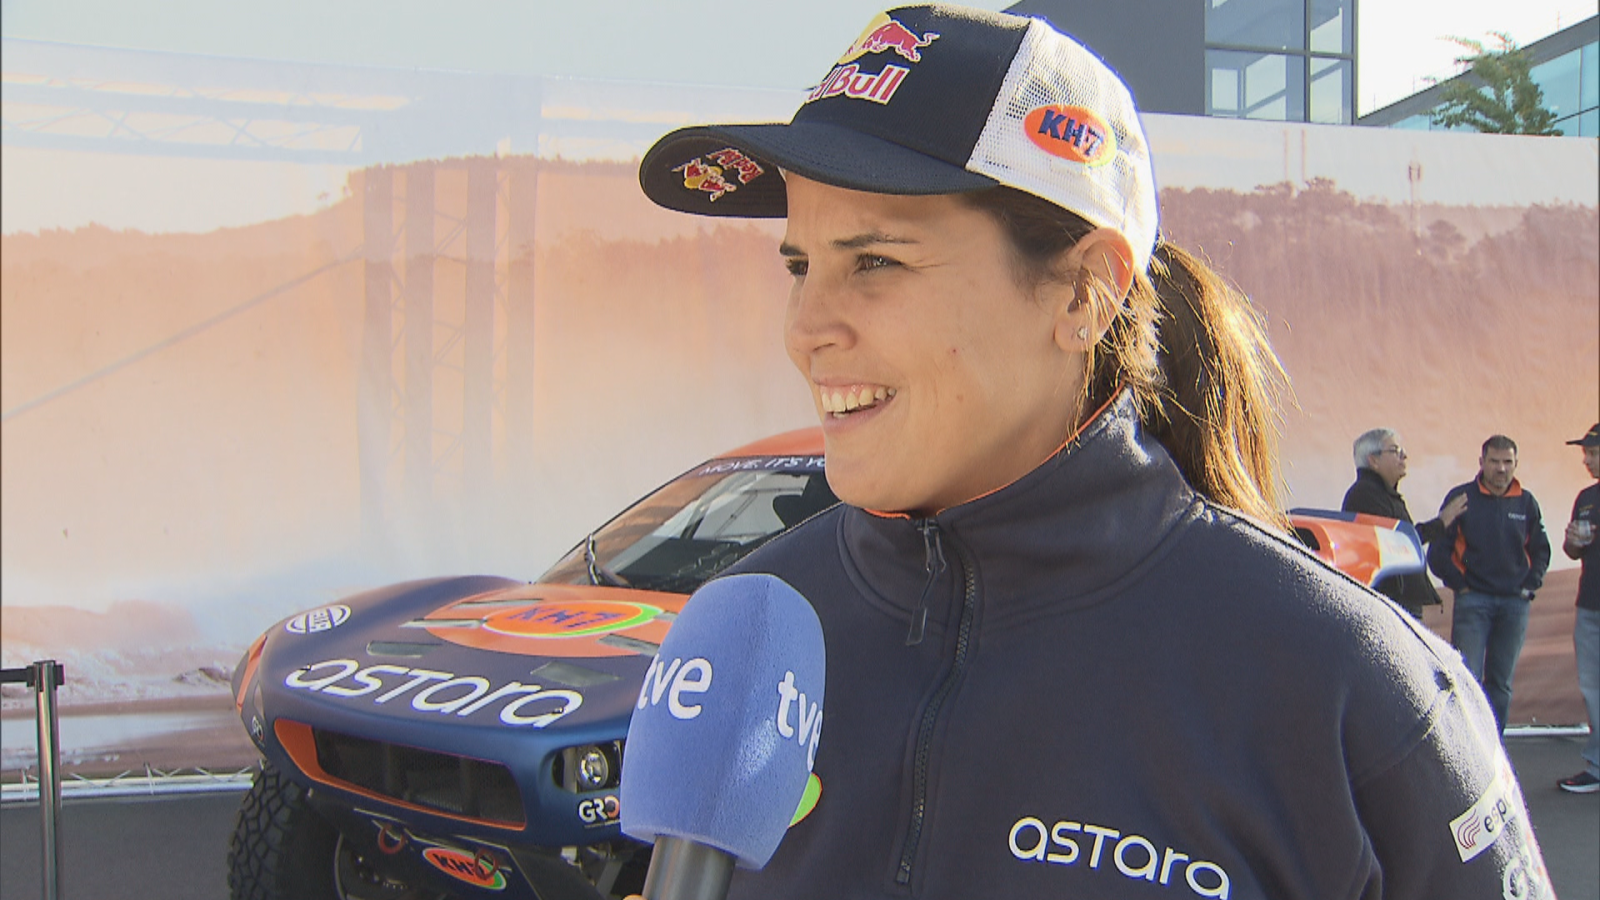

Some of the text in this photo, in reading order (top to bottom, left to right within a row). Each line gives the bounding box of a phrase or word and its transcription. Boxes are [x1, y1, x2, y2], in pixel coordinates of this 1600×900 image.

[824, 65, 908, 103] Bull
[1038, 110, 1104, 156] KH7
[507, 606, 626, 628] KH7
